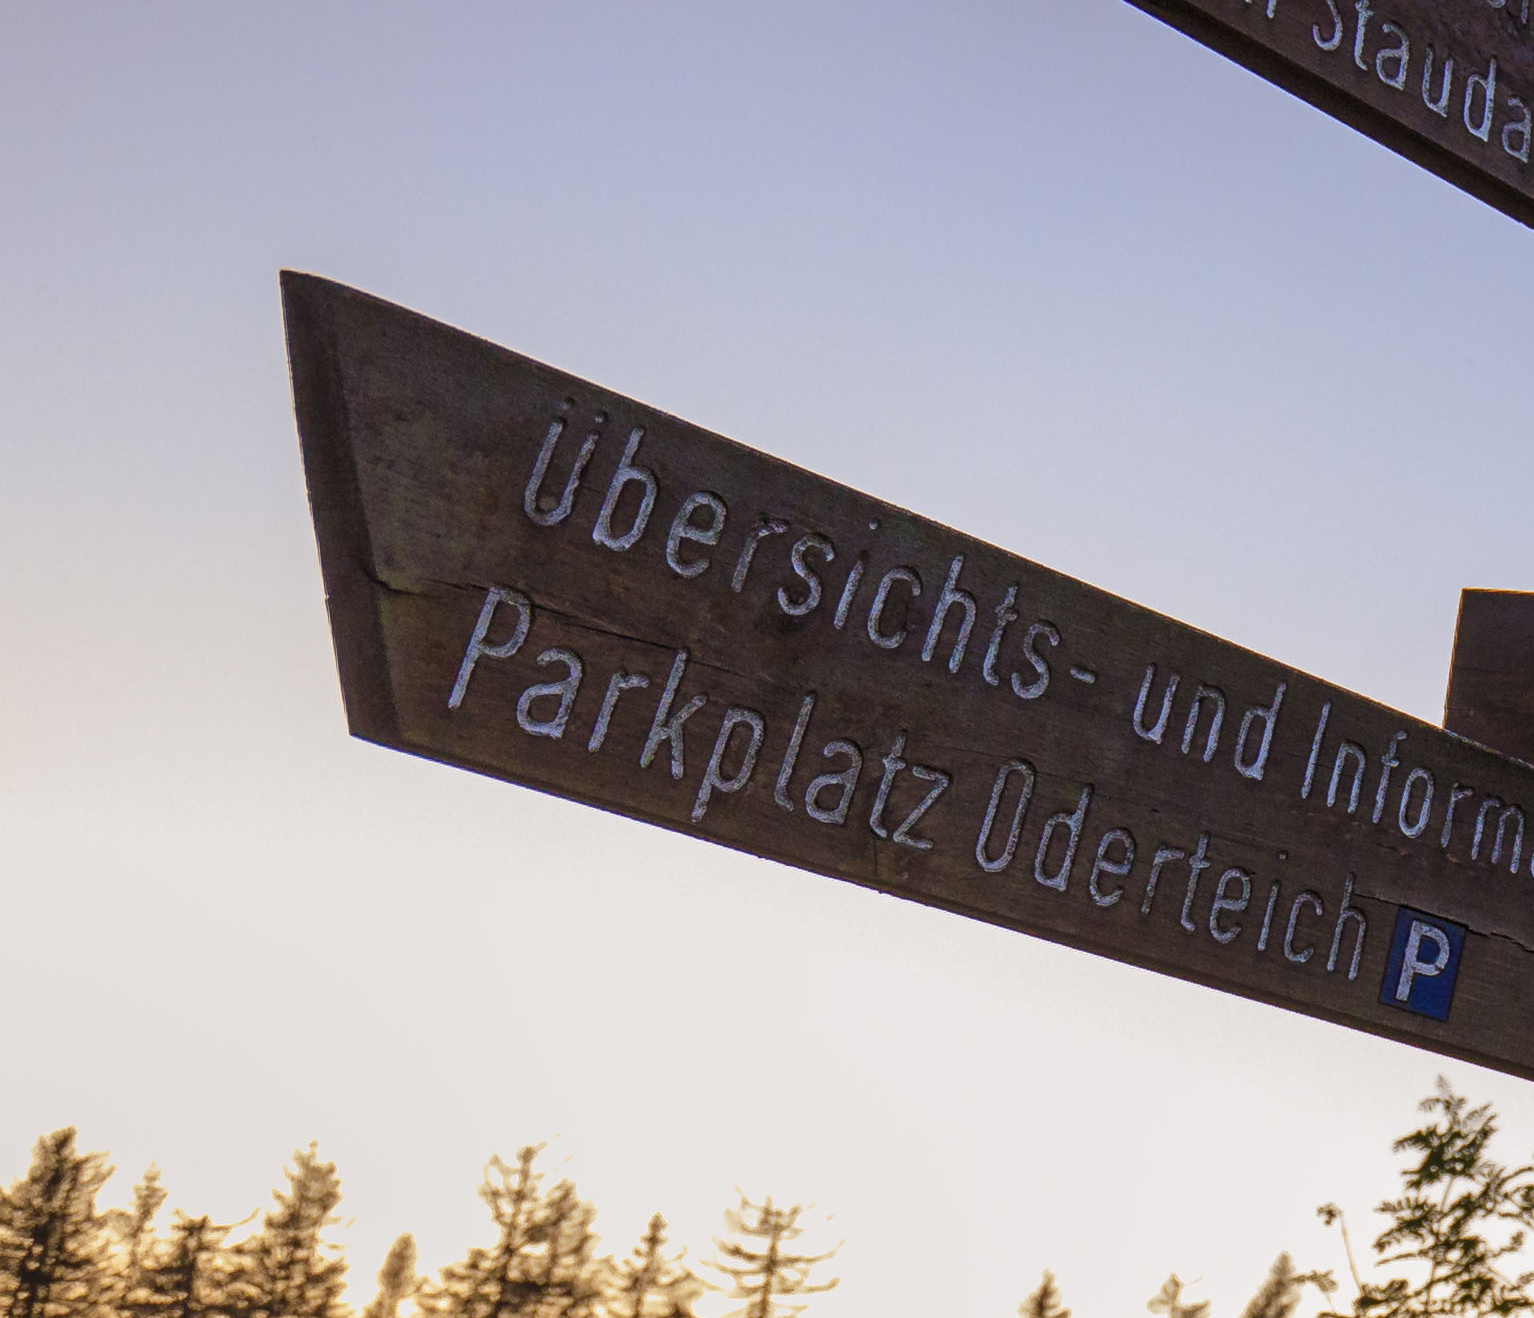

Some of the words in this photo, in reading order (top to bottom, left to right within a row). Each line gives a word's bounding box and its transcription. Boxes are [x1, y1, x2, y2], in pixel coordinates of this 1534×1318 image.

[523, 396, 1096, 699] Übersichts-
[1132, 663, 1287, 780] und
[447, 586, 950, 851] Parkplatz
[975, 758, 1366, 981] Oderteich
[1394, 919, 1451, 1002] P
